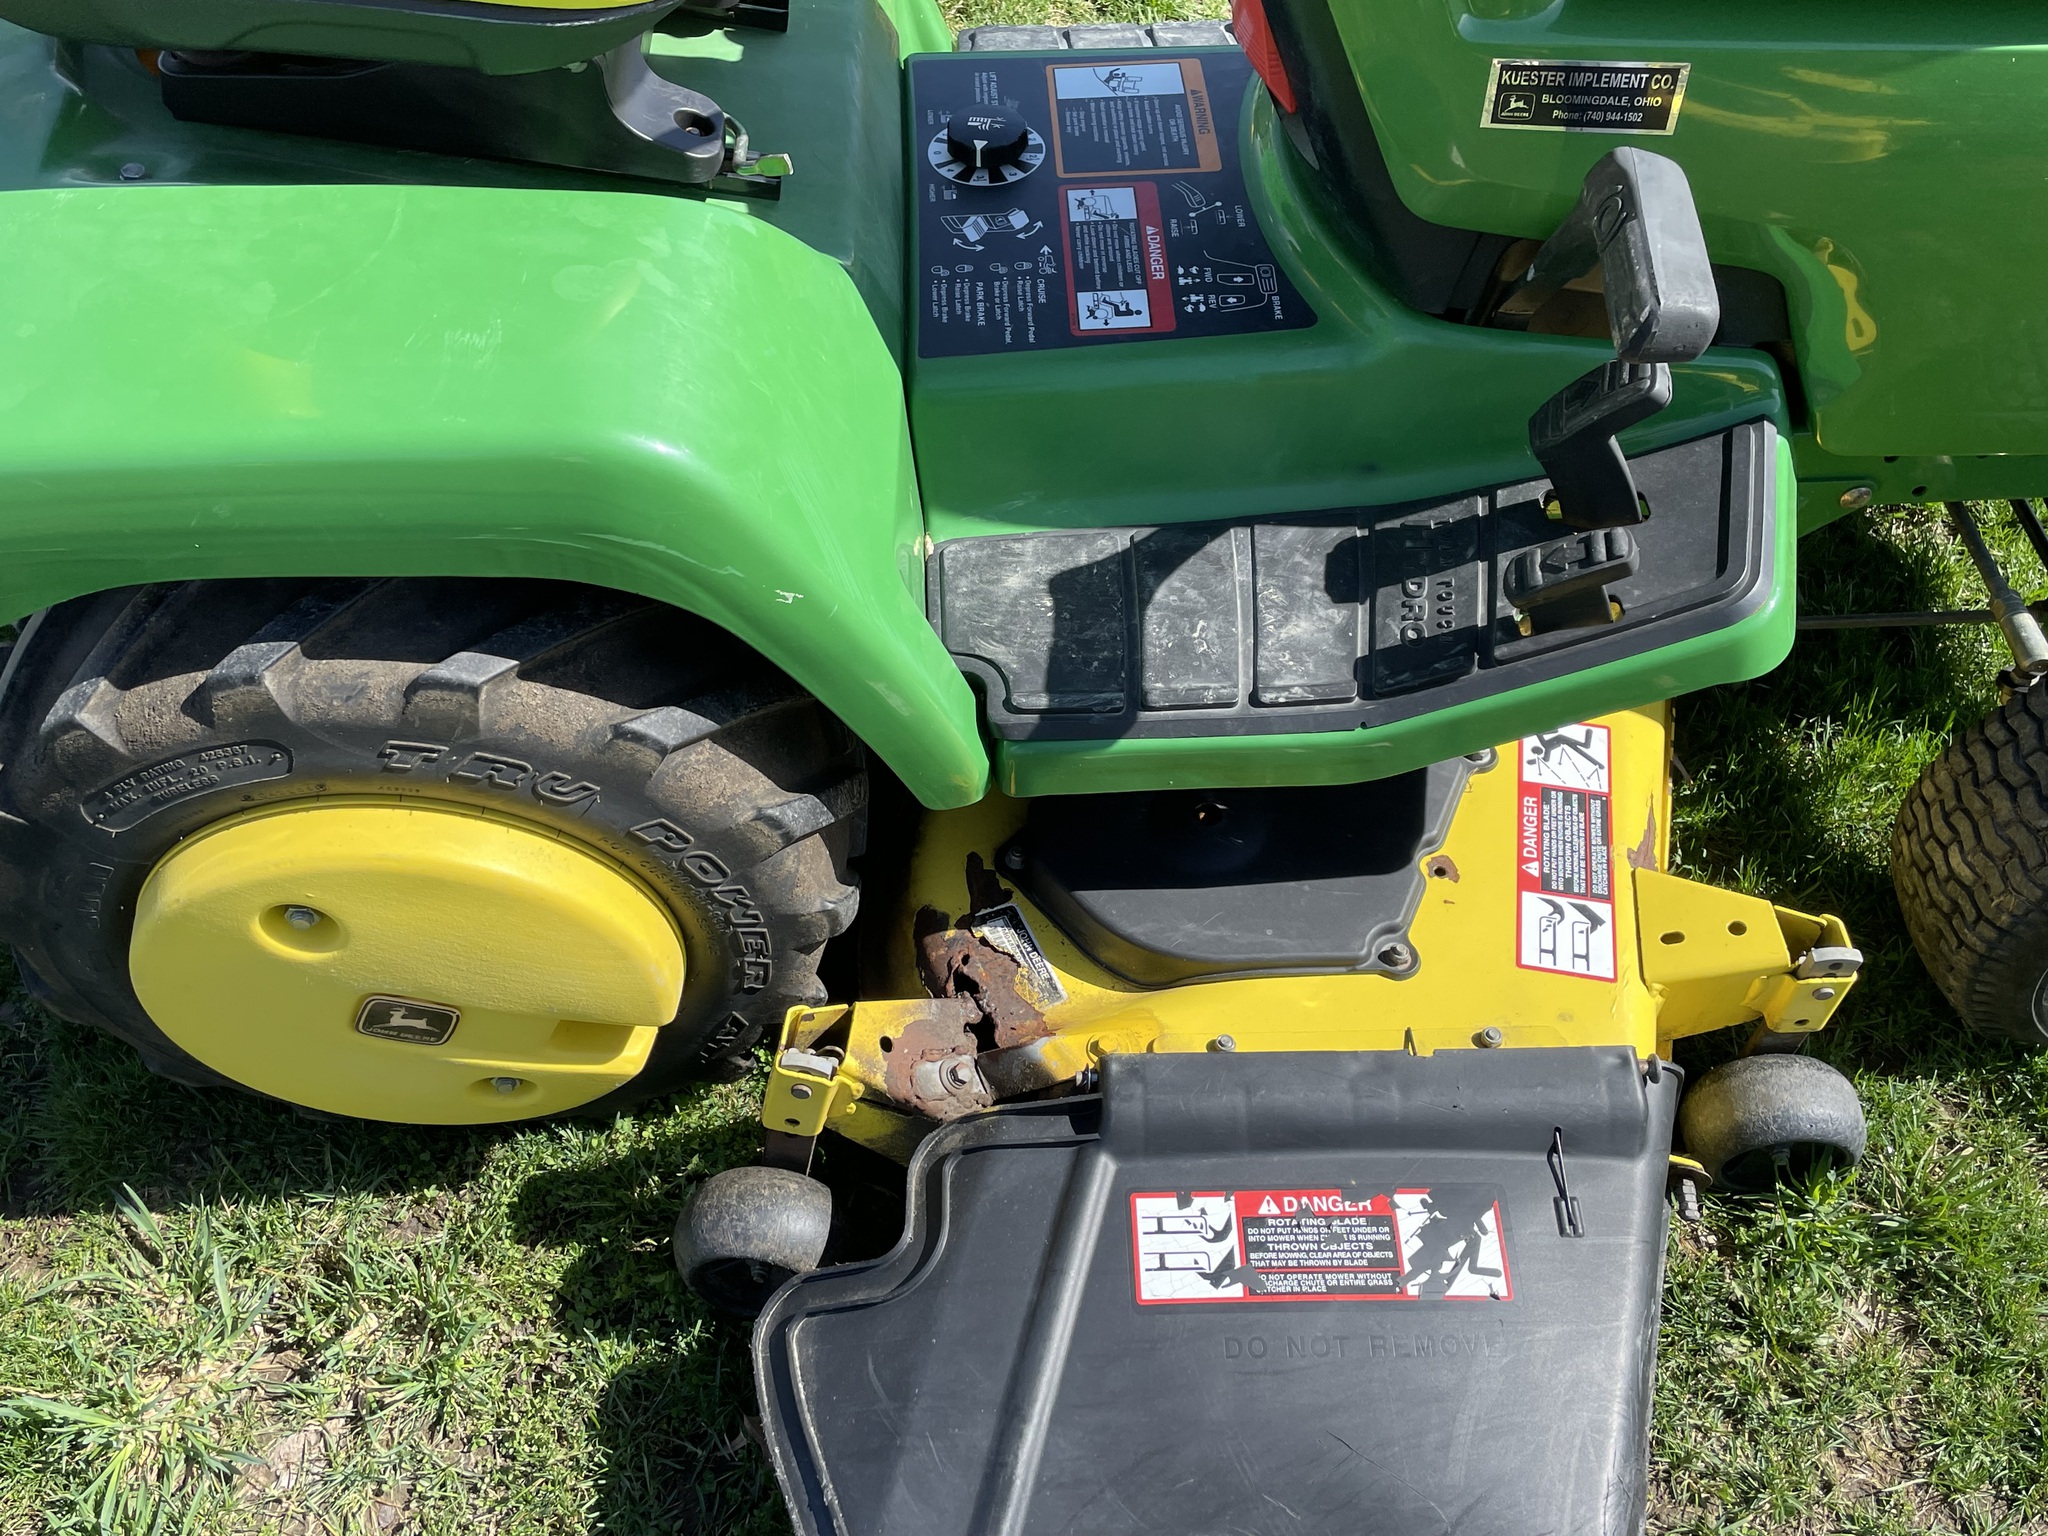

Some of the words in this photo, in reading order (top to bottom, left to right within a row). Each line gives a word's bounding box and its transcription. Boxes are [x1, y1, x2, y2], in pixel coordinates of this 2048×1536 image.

[1501, 71, 1565, 86] KUESTER
[1568, 72, 1649, 88] IMPLEMENT
[1651, 74, 1674, 89] CO.
[1541, 94, 1631, 107] BLOOMINGDALE,
[1634, 97, 1662, 106] OHIO
[1192, 95, 1210, 134] WARNING
[1553, 110, 1582, 120] Phone:
[1583, 112, 1604, 122] (740)
[1606, 112, 1643, 122] 944-1502
[1235, 205, 1245, 227] LOWER
[1170, 219, 1179, 237] RAISE
[1147, 235, 1165, 279] DANGER
[1204, 267, 1213, 282] FWD
[940, 284, 948, 305] Depress
[975, 282, 984, 300] PARK
[993, 281, 1001, 296] Brake
[1001, 280, 1009, 303] Depress
[1037, 279, 1046, 304] CRUISE
[1208, 294, 1217, 309] REV
[1272, 296, 1283, 320] BRAKE
[977, 302, 985, 326] BRAKE
[1028, 327, 1036, 343] Pedal
[114, 777, 137, 793] PLY
[140, 758, 186, 780] RATING
[190, 764, 209, 777] 20
[377, 739, 601, 804] TRU
[1523, 796, 1537, 858] DANGER
[1552, 881, 1557, 889] DO
[629, 817, 772, 990] POWER
[1016, 927, 1034, 952] JOHN
[1028, 951, 1051, 980] DEERE
[1267, 1243, 1318, 1251] THROWN
[1224, 1335, 1268, 1359] DO
[1286, 1334, 1349, 1359] NOT
[1369, 1334, 1502, 1358] REMOVE
